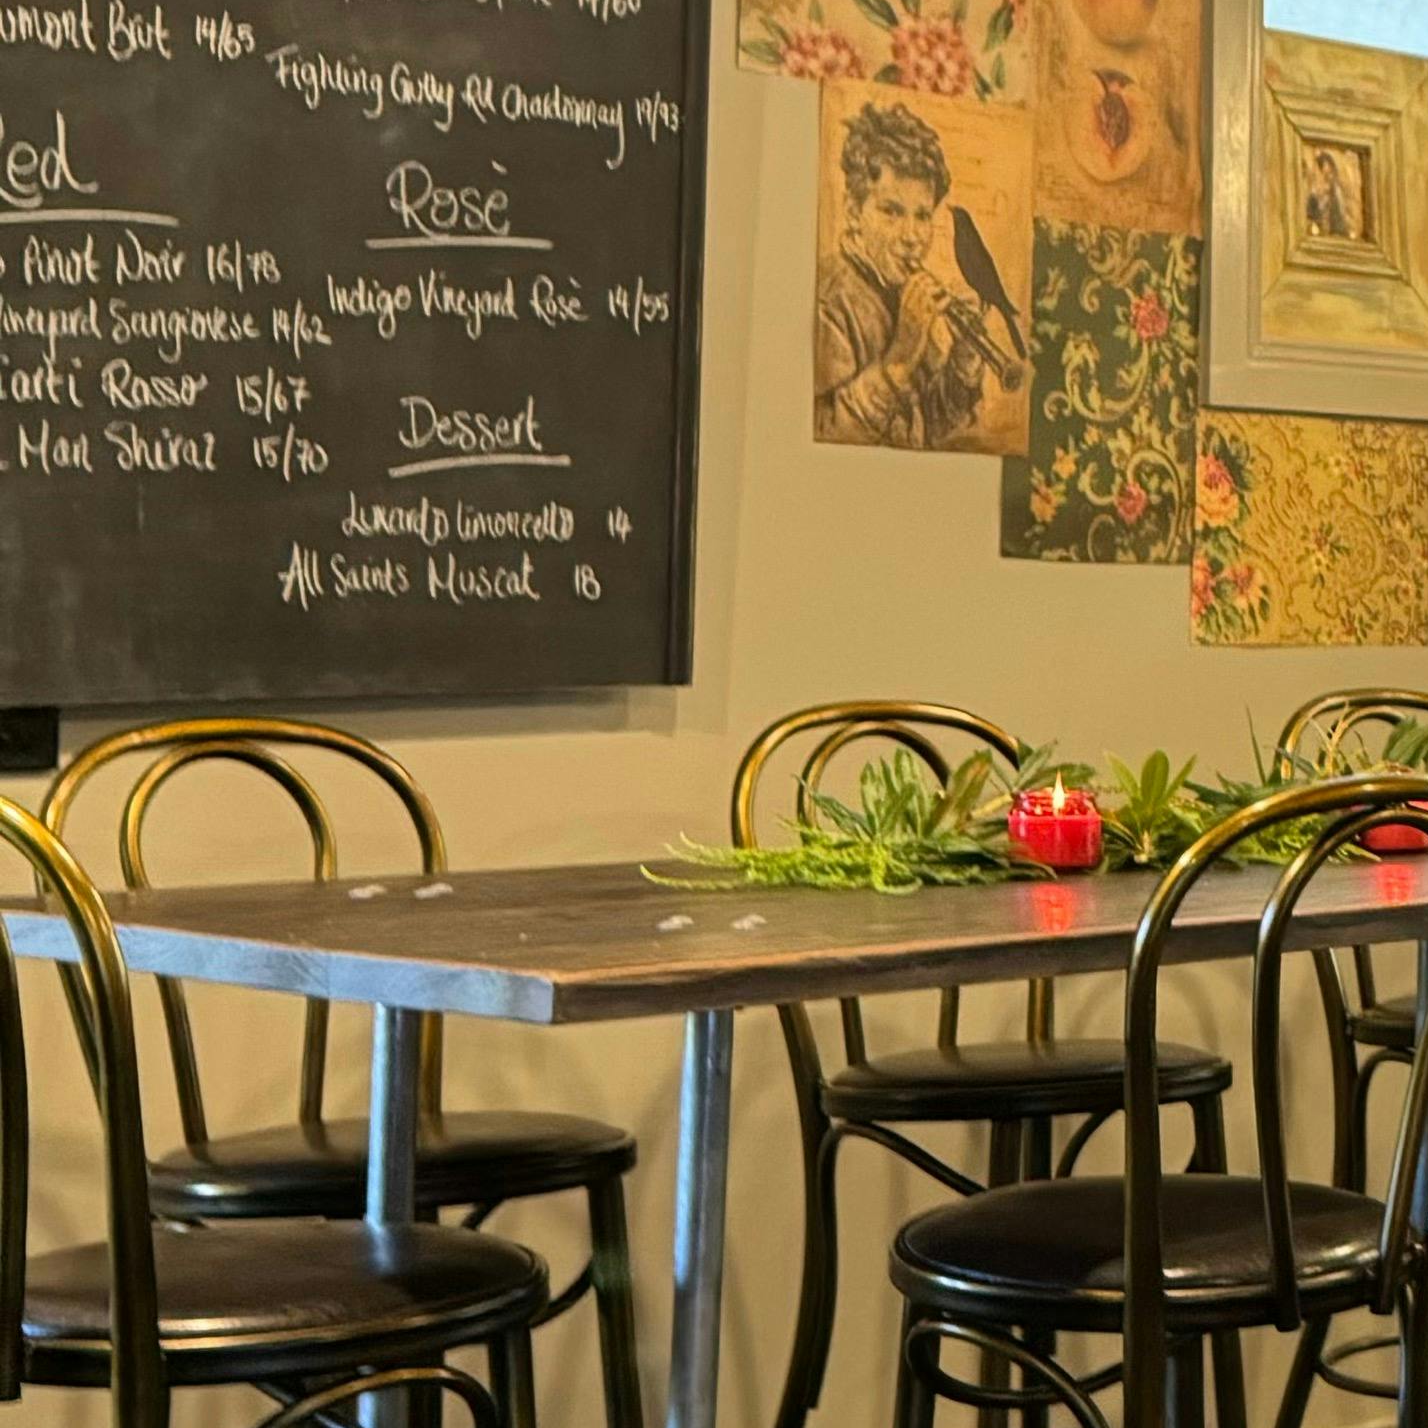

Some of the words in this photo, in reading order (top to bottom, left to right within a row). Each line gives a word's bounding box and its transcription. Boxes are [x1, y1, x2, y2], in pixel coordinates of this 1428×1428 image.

[265, 43, 384, 120] Fighting
[502, 83, 625, 170] Chardonnay
[24, 233, 101, 286] Pinot
[116, 228, 186, 286] Noir
[327, 274, 412, 340] Indigo
[419, 269, 519, 341] Vineyard
[399, 395, 542, 453] Dessert
[278, 541, 324, 612] All
[330, 553, 410, 598] Saints
[427, 550, 541, 606] Muscat
